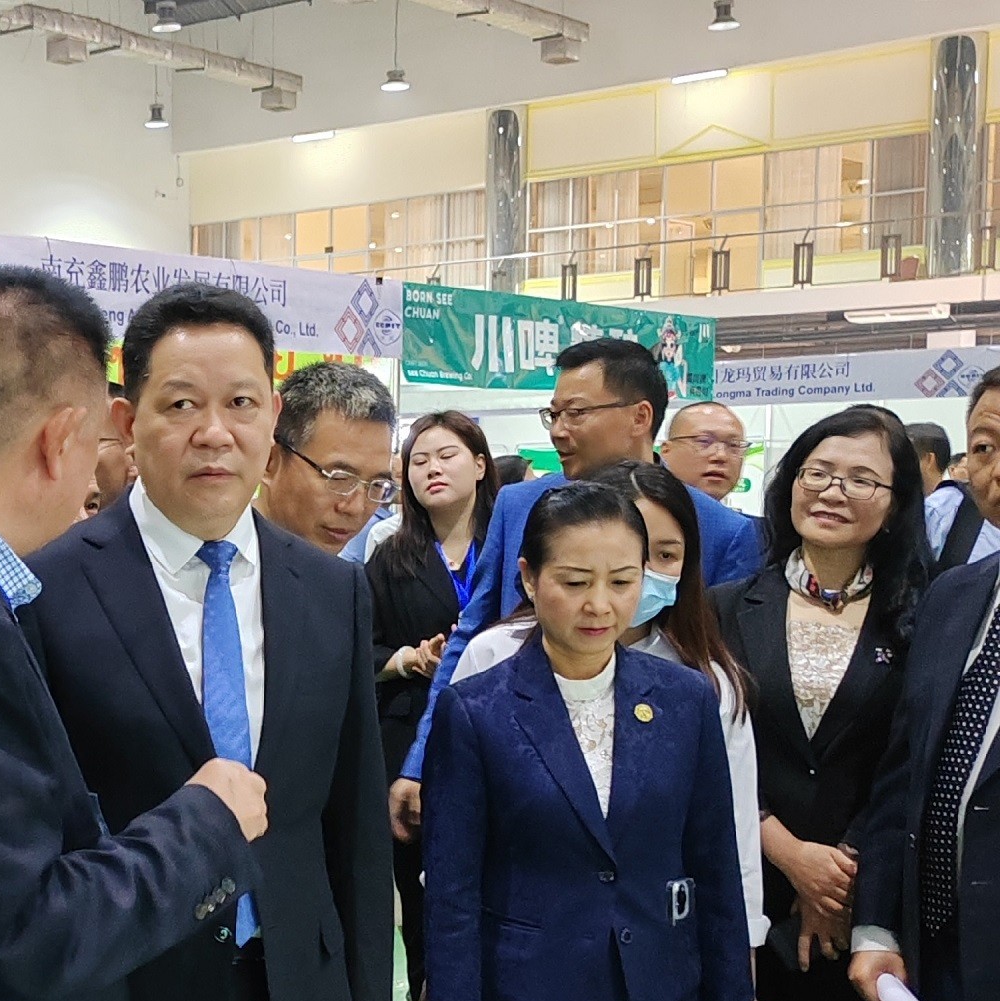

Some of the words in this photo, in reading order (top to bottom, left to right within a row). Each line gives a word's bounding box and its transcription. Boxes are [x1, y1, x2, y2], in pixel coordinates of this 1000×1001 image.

[405, 289, 433, 303] BORN
[436, 292, 453, 306] SEE
[404, 305, 441, 320] CHUAN
[299, 322, 320, 338] Ltd.
[715, 361, 850, 384] 龙玛贸易有限公司
[713, 389, 751, 399] ongma
[755, 385, 795, 398] Trading
[798, 380, 851, 397] Company
[854, 382, 876, 393] Ltd.
